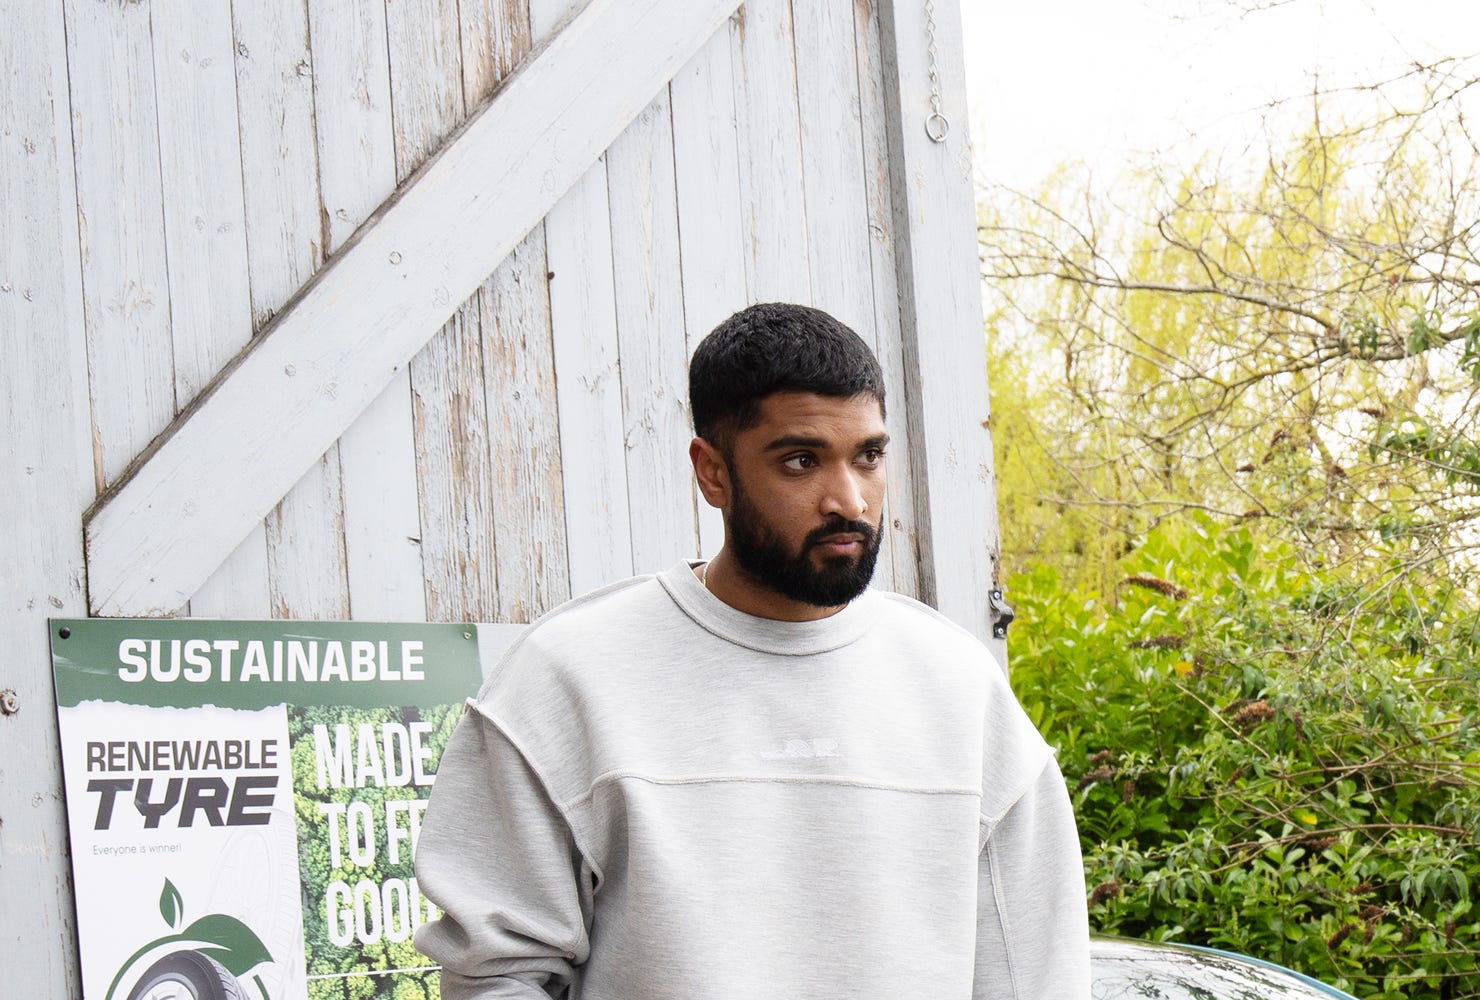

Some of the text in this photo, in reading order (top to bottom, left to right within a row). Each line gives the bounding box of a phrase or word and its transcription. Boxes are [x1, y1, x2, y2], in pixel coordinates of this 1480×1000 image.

[118, 638, 425, 682] SUSTAINABLE
[86, 739, 278, 772] RENEWABLE
[313, 721, 437, 789] MADE
[86, 775, 279, 830] TYRE
[92, 842, 182, 856] Everyone is winner!
[319, 801, 376, 869] TO
